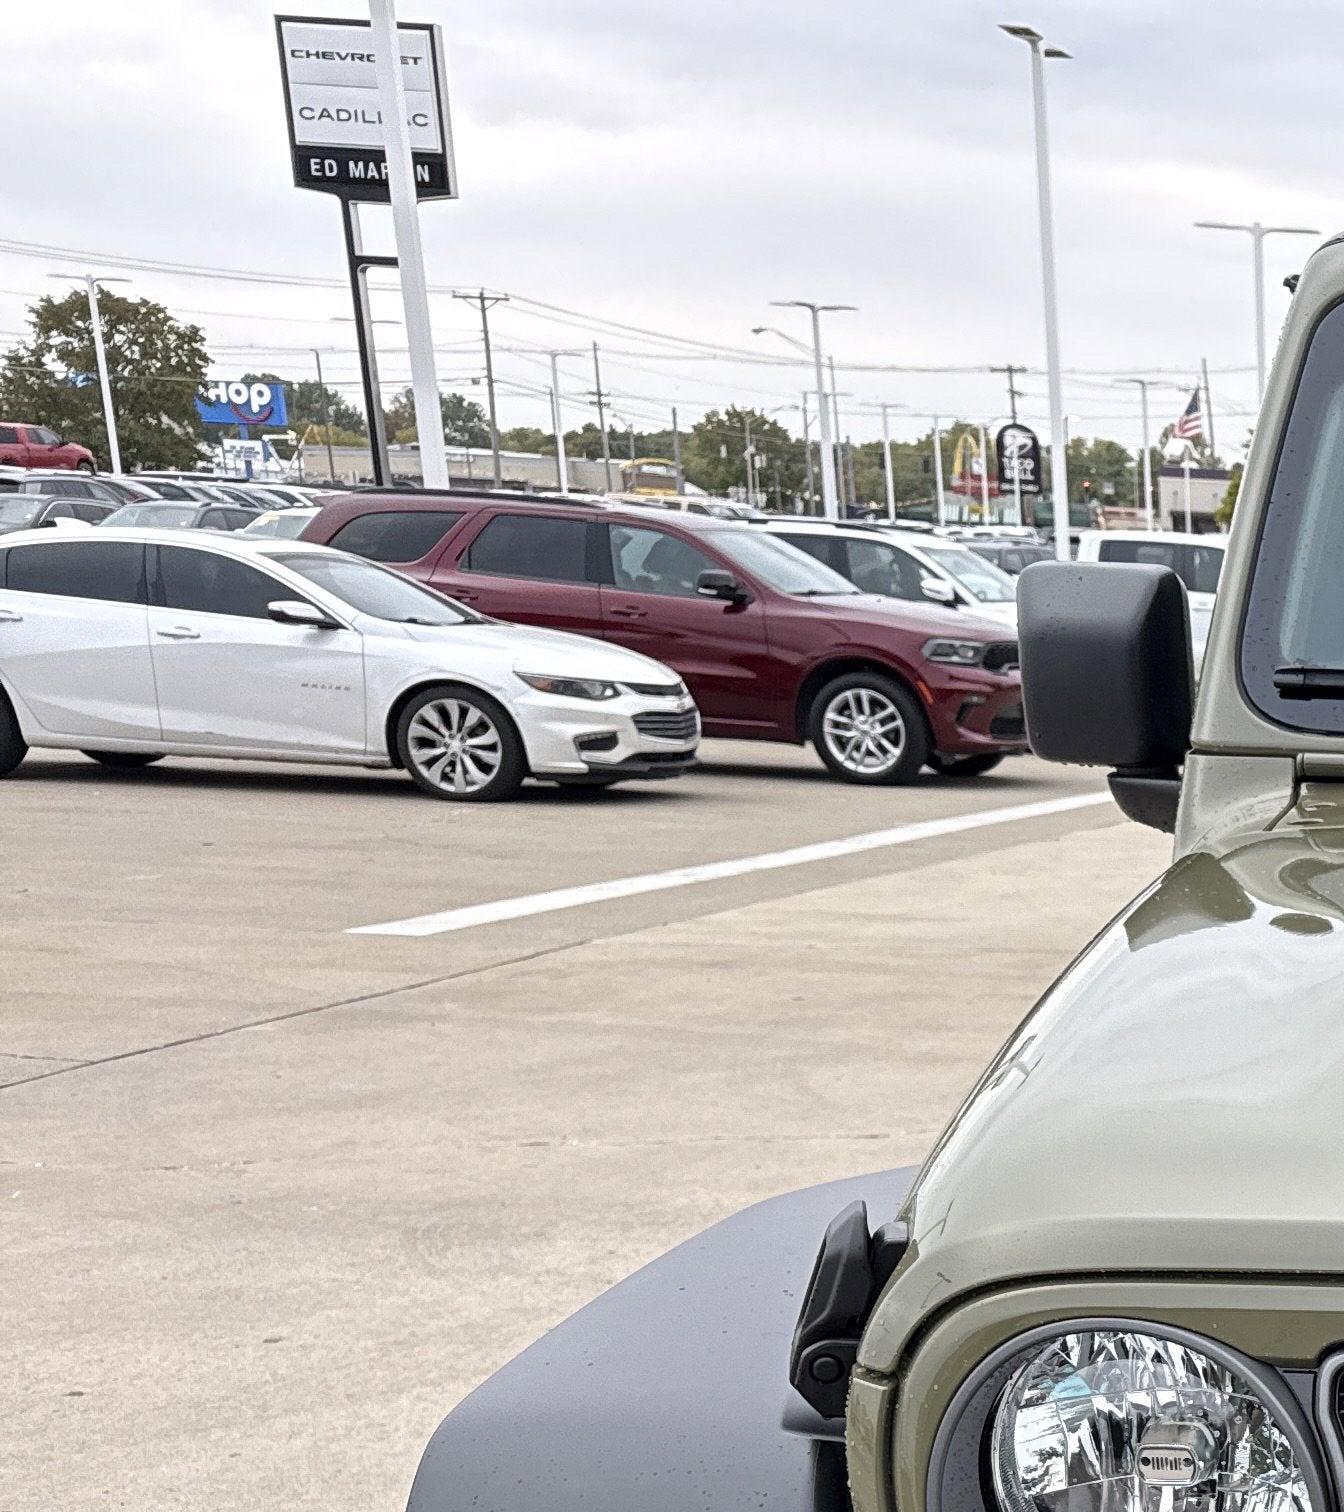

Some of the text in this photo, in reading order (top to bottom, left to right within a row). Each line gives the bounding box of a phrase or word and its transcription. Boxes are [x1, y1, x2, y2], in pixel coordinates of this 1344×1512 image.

[290, 49, 422, 66] CHEVROET
[309, 158, 430, 183] ED MARN
